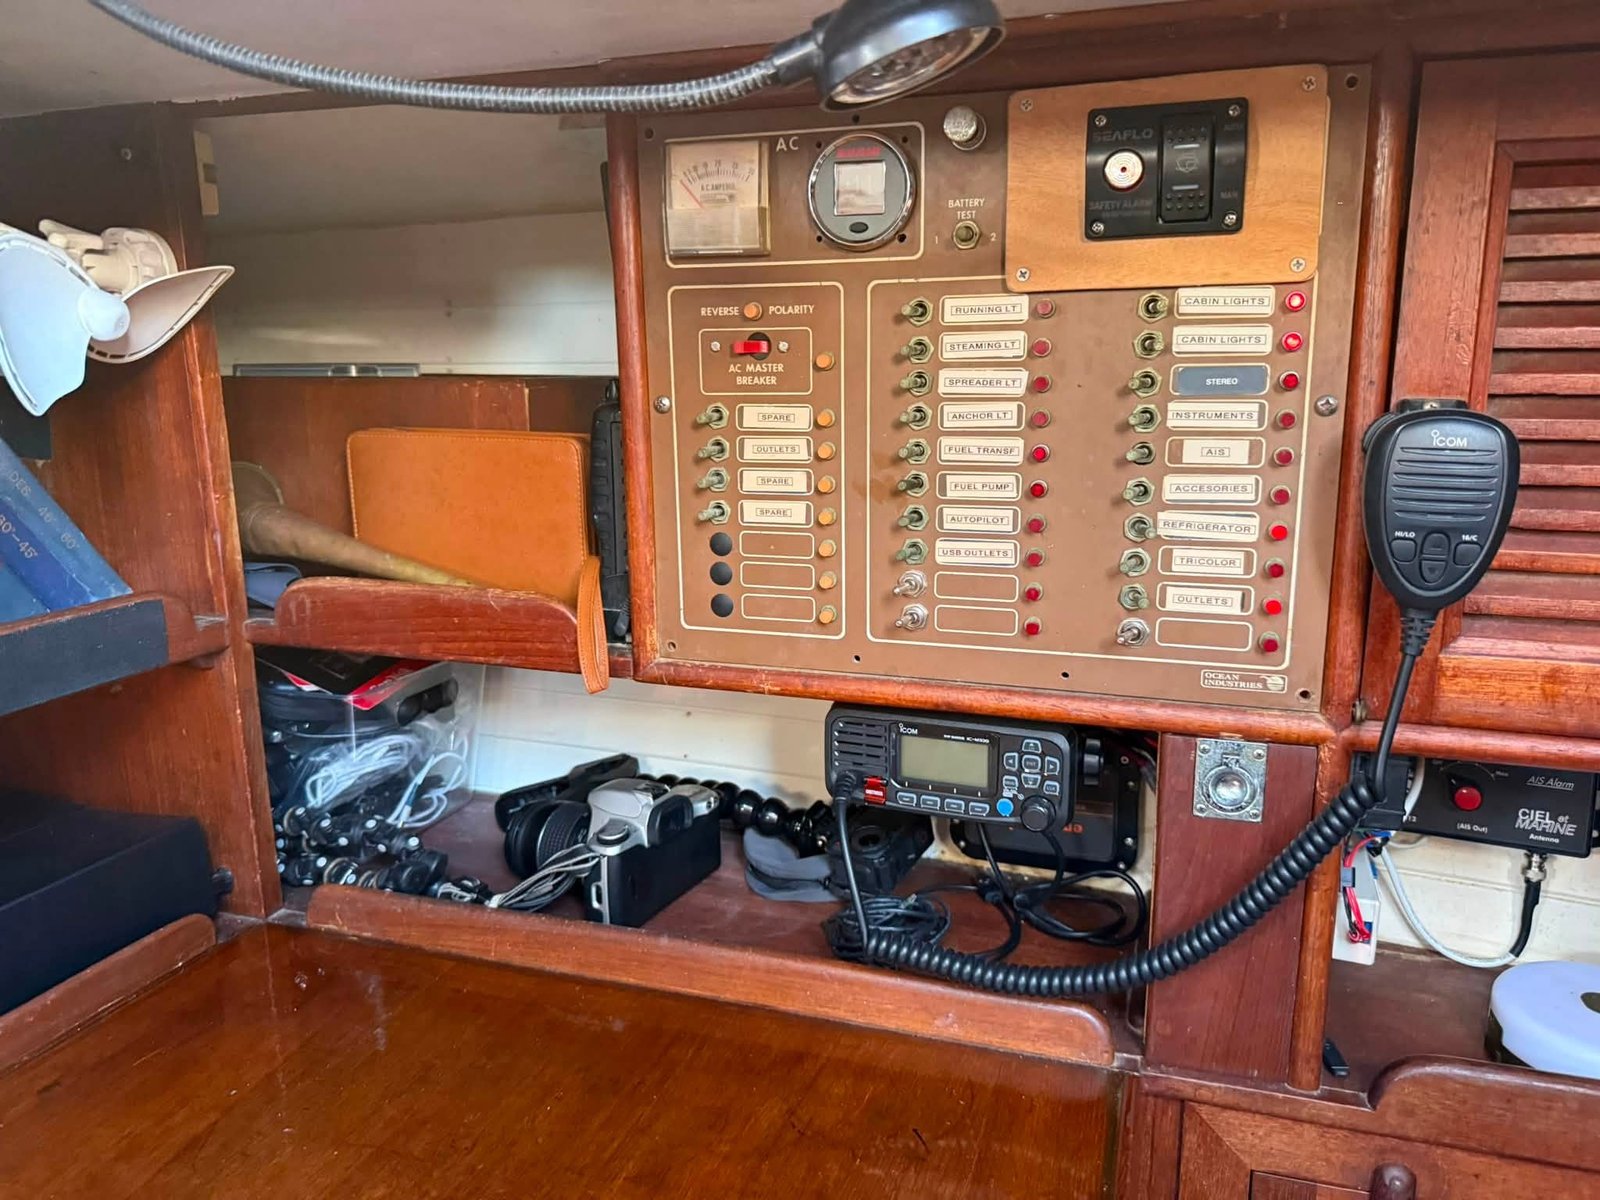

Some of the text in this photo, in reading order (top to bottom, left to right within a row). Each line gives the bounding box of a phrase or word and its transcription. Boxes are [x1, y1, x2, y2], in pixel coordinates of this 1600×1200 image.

[776, 136, 799, 151] AC
[948, 198, 985, 208] BATTERY
[957, 210, 977, 220] TEST
[990, 232, 997, 242] 2
[1223, 297, 1265, 305] LIGHTS
[700, 304, 815, 316] REVERSE POLARITY
[955, 306, 1003, 314] RUNNING
[1182, 336, 1216, 344] CABIN
[949, 342, 1002, 350] STEAMING
[728, 363, 784, 373] AC MASTER
[736, 376, 777, 385] BREAKER
[948, 378, 1003, 386] SPREADER
[1205, 377, 1238, 386] STEREO
[761, 414, 791, 422] SPARE
[951, 412, 994, 420] ANCHOR
[1171, 411, 1254, 419] INSTRUMENTS
[756, 445, 797, 453] OUTLETS
[948, 446, 1016, 455] FUEL TRANSF
[1205, 448, 1225, 456] AIS
[760, 477, 789, 485] SPARE
[981, 483, 1010, 491] PUMP
[1174, 484, 1248, 493] ACCESORIES
[759, 508, 788, 516] SPARE
[950, 515, 1005, 524] AUTOPILOT
[1162, 520, 1251, 533] REFRIGERATOR
[1179, 557, 1236, 566] TRICOLOR
[1177, 595, 1229, 606] OUTLETS
[1204, 672, 1240, 681] OCEAN
[1204, 678, 1263, 689] INDUSTRIES
[1527, 775, 1575, 790] AIS Alarm
[1518, 808, 1551, 823] CIEL
[1515, 818, 1577, 836] MARINE
[1529, 833, 1560, 843] Antenna
